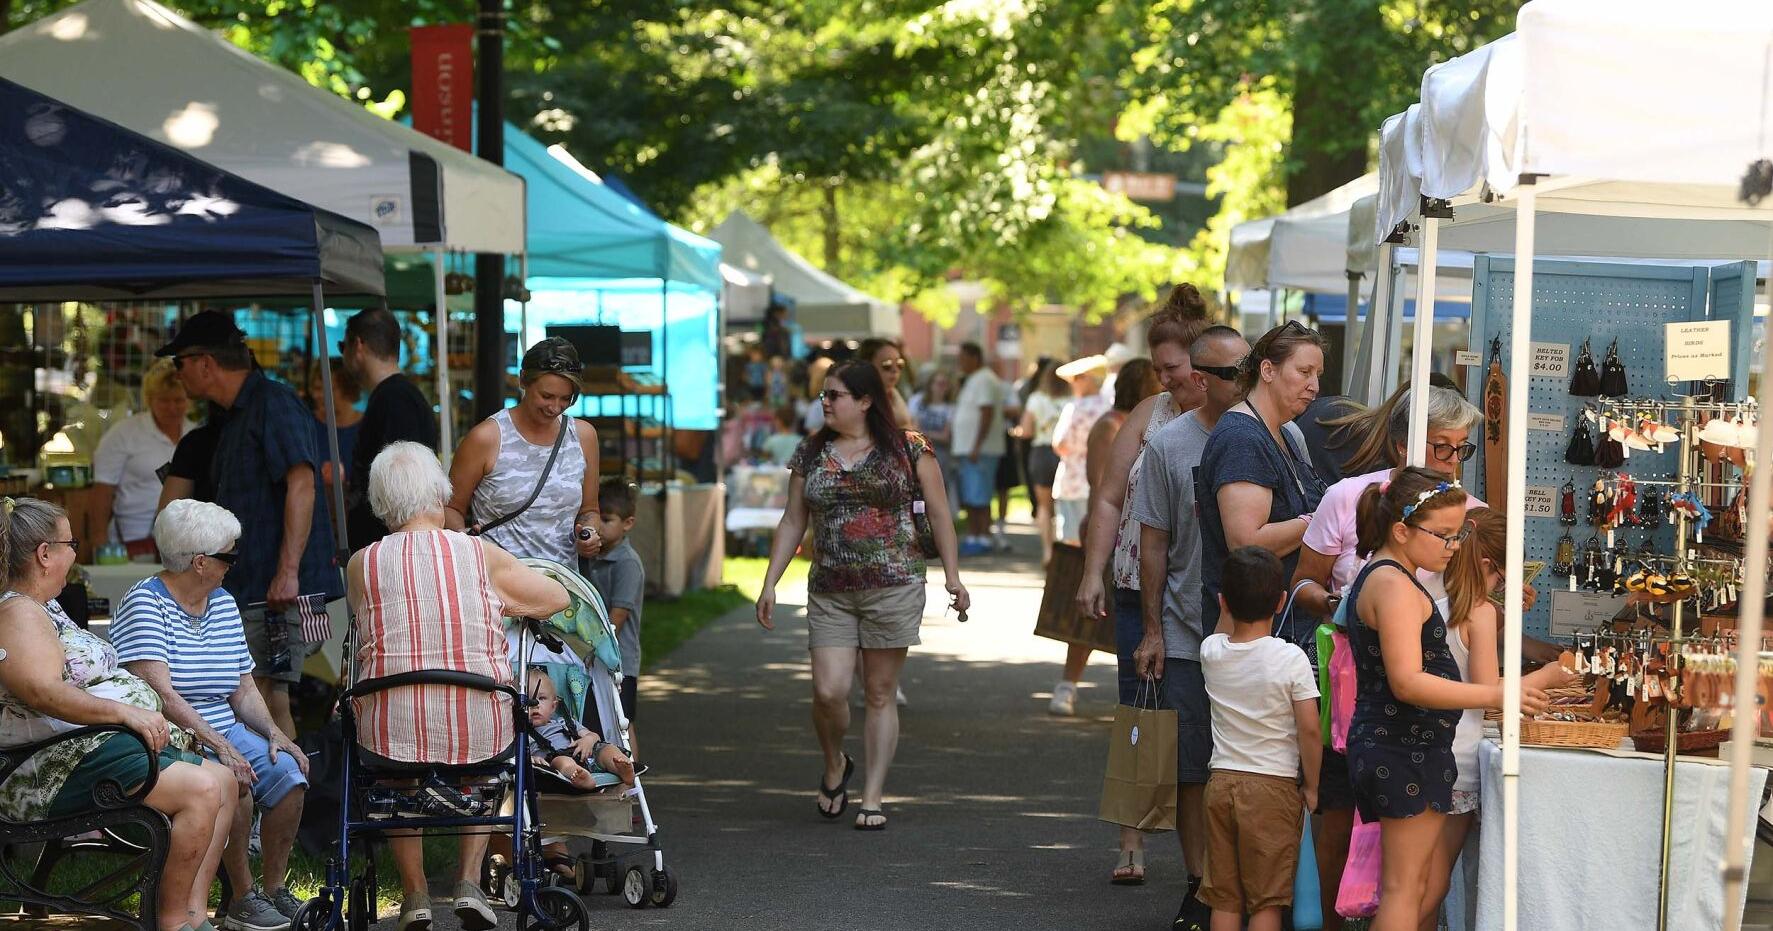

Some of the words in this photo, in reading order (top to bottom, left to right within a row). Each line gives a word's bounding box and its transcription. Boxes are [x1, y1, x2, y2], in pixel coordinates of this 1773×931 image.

[434, 52, 454, 146] inson
[1533, 362, 1562, 371] $4.00
[1524, 503, 1551, 513] $1.50
